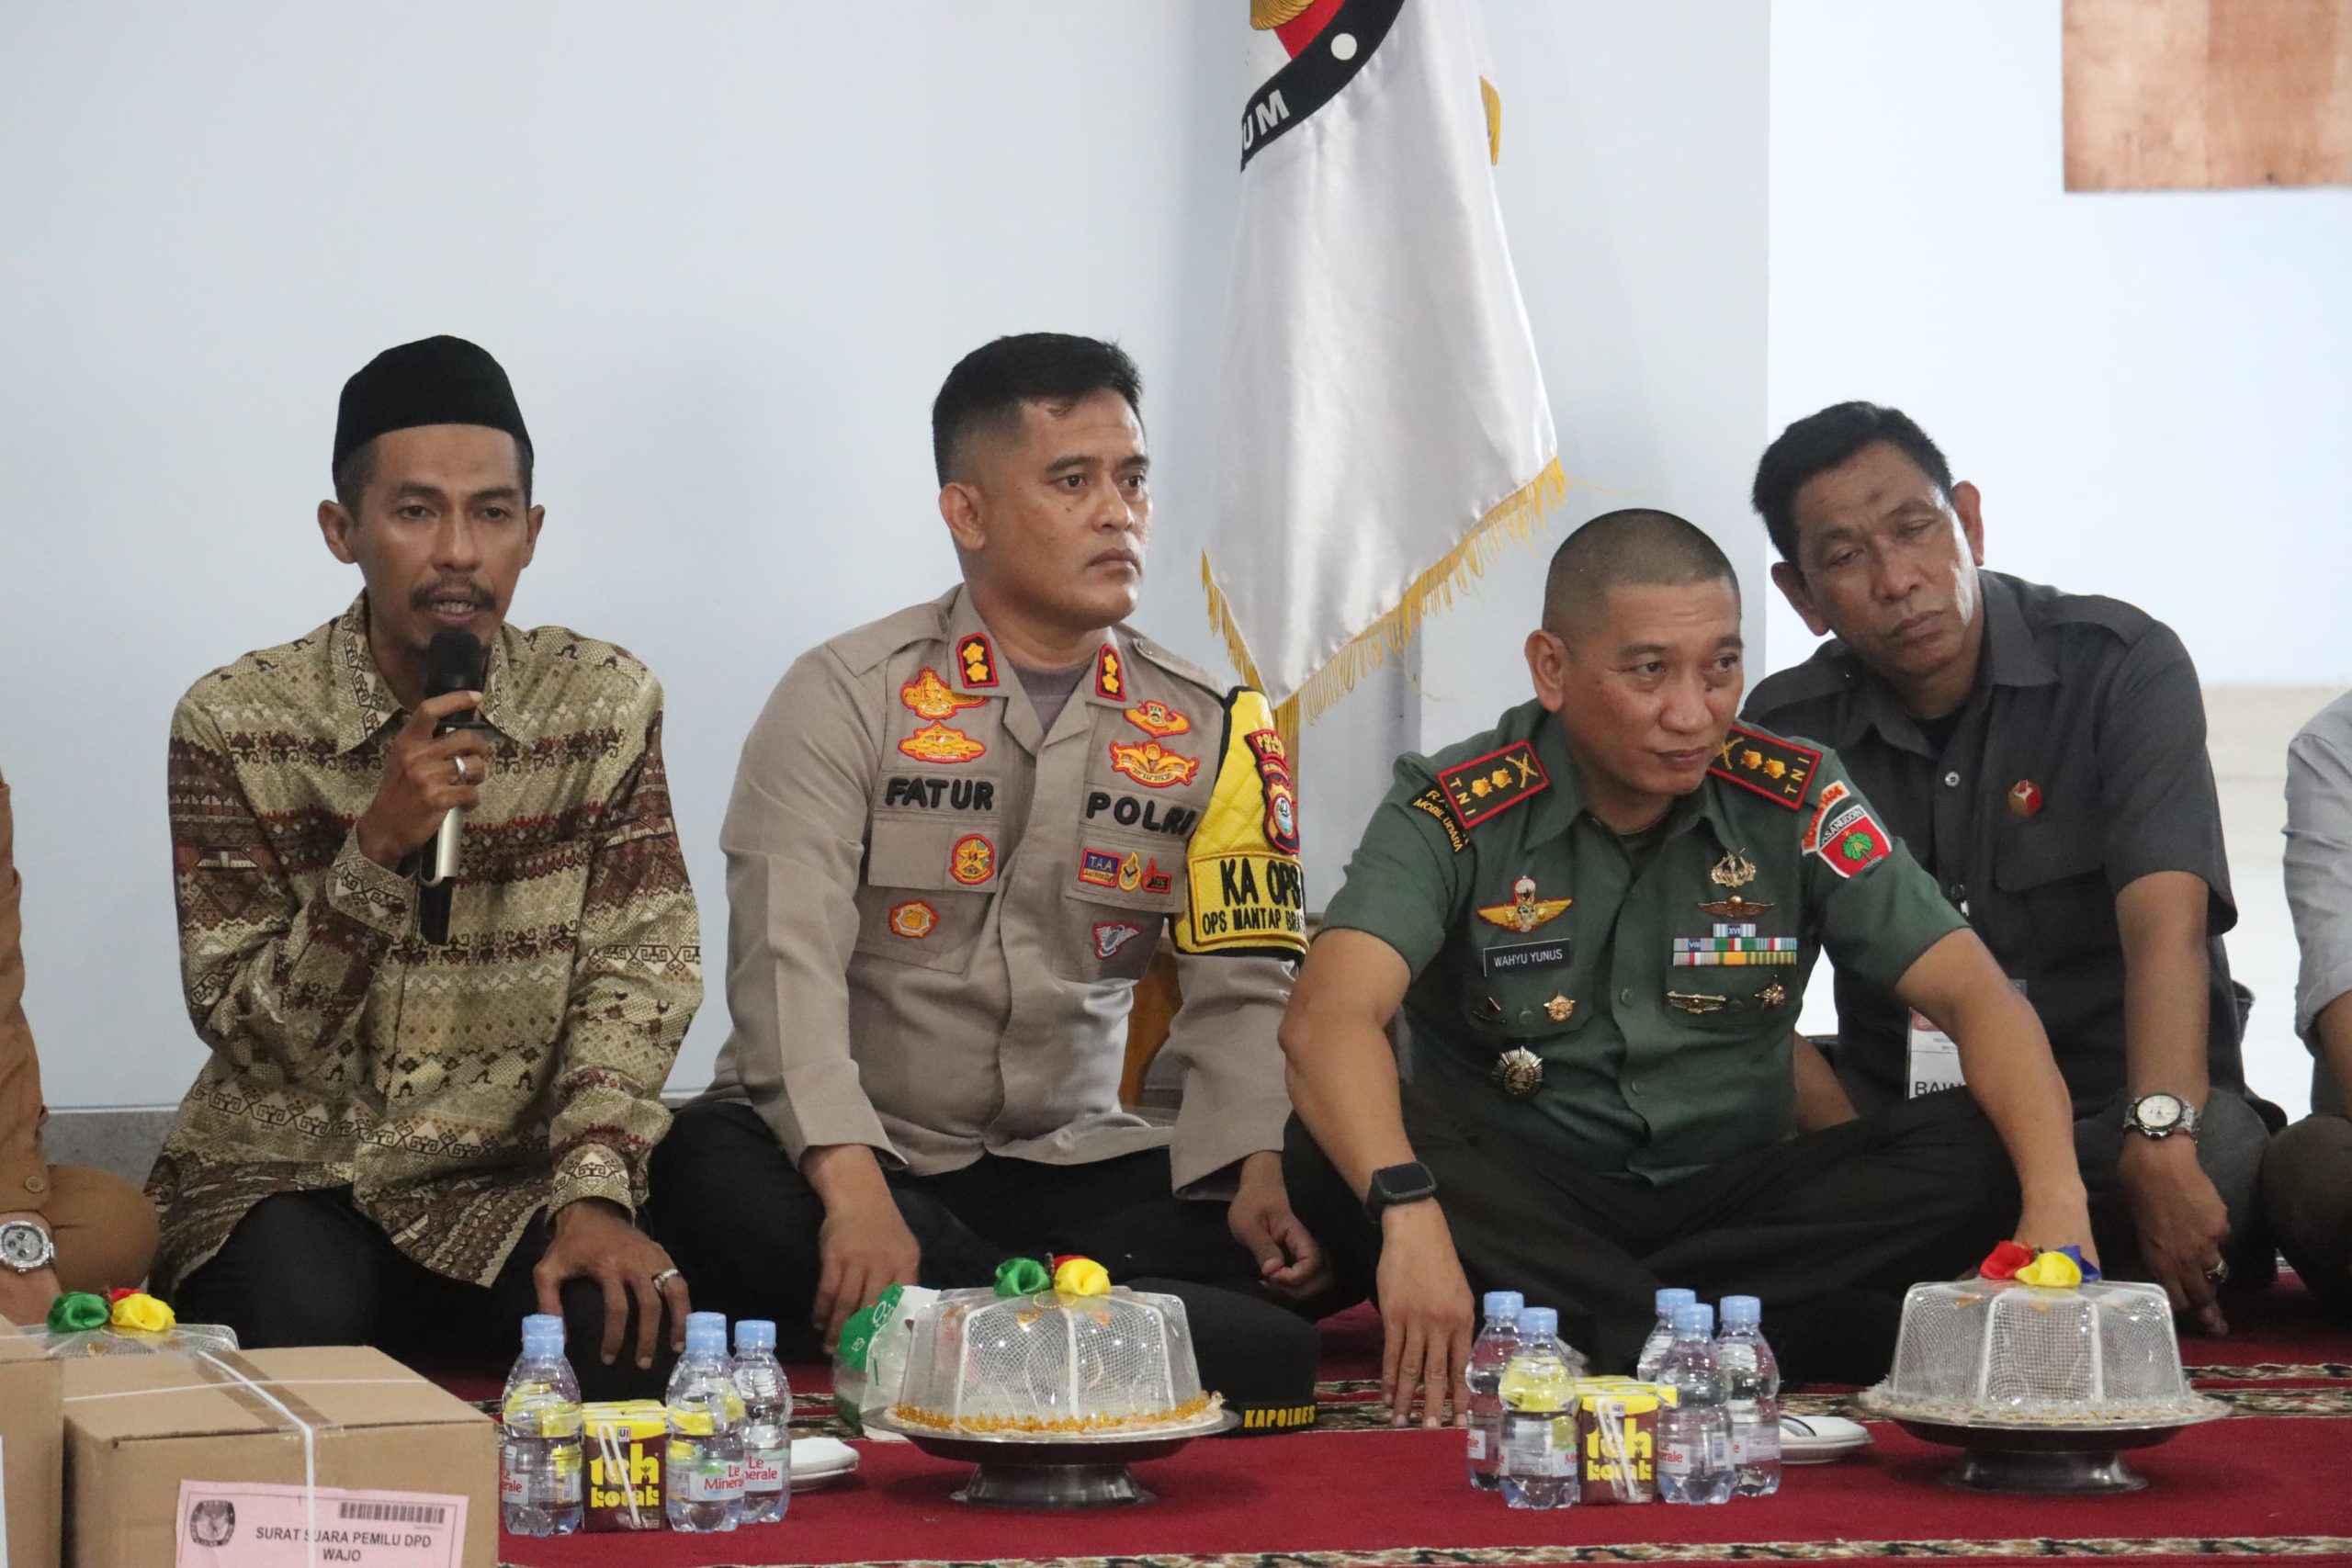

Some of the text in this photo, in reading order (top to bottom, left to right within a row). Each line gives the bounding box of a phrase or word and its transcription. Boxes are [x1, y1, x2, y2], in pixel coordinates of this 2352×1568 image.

[1784, 757, 1811, 795] TNI
[885, 777, 994, 810] FATUR
[1450, 777, 1476, 816] TNI
[1086, 791, 1197, 836] POLRI
[1413, 798, 1445, 819] MOBIL
[1442, 817, 1464, 852] UDARA
[1220, 857, 1259, 908] KA
[1203, 910, 1227, 935] OPS
[1232, 907, 1282, 931] MANTAP
[1494, 948, 1564, 967] WAHYU YUNUS
[1244, 1404, 1317, 1428] KAPOLRES
[729, 1465, 740, 1478] Le
[749, 1456, 764, 1470] Le
[255, 1526, 300, 1540] SURAT
[353, 1531, 401, 1545] PEMILU
[404, 1534, 432, 1548] DPD
[322, 1548, 361, 1562] WAJO
